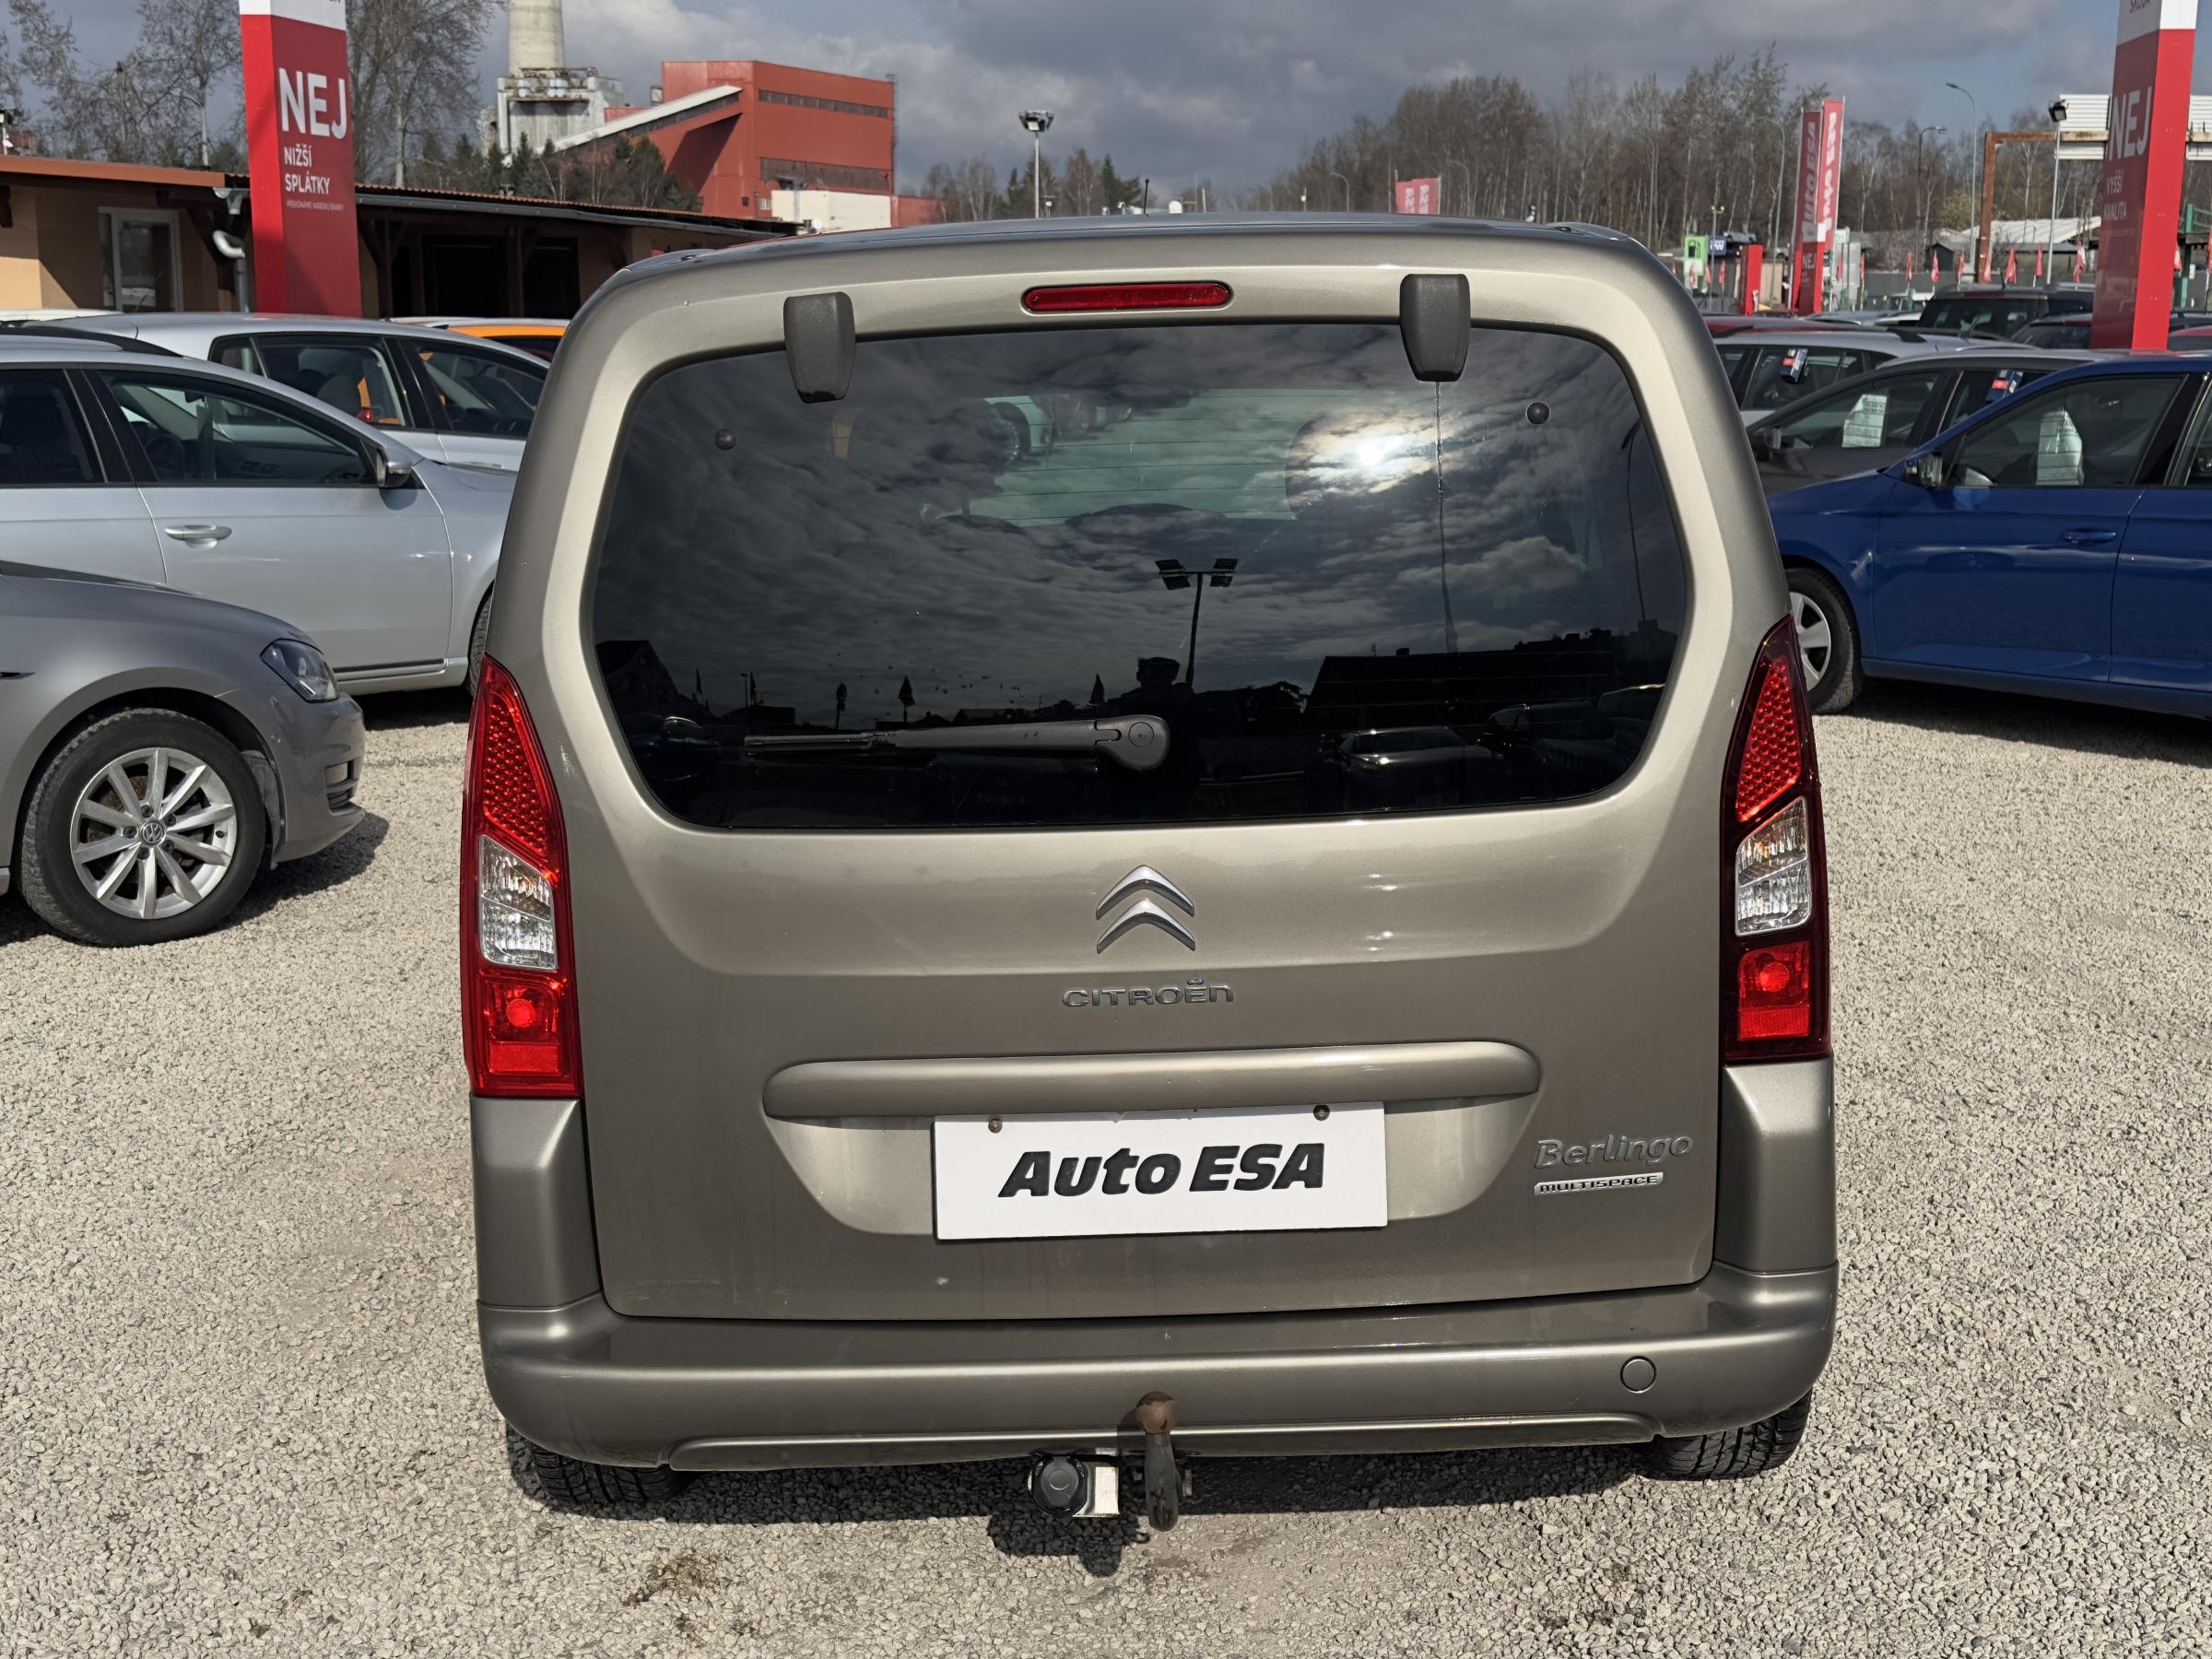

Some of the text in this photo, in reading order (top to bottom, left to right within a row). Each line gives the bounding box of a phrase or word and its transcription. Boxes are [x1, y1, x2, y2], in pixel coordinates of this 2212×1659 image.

[278, 67, 347, 139] NEJ
[2108, 86, 2152, 161] NEJ
[283, 142, 312, 168] NIŽŠÍ
[285, 171, 331, 194] SPLÁTKY
[1062, 978, 1234, 1007] CITROËN
[1534, 1135, 1694, 1170] Berlingo
[997, 1143, 1325, 1197] Auto ESA
[1539, 1175, 1658, 1194] MULTISPACE
